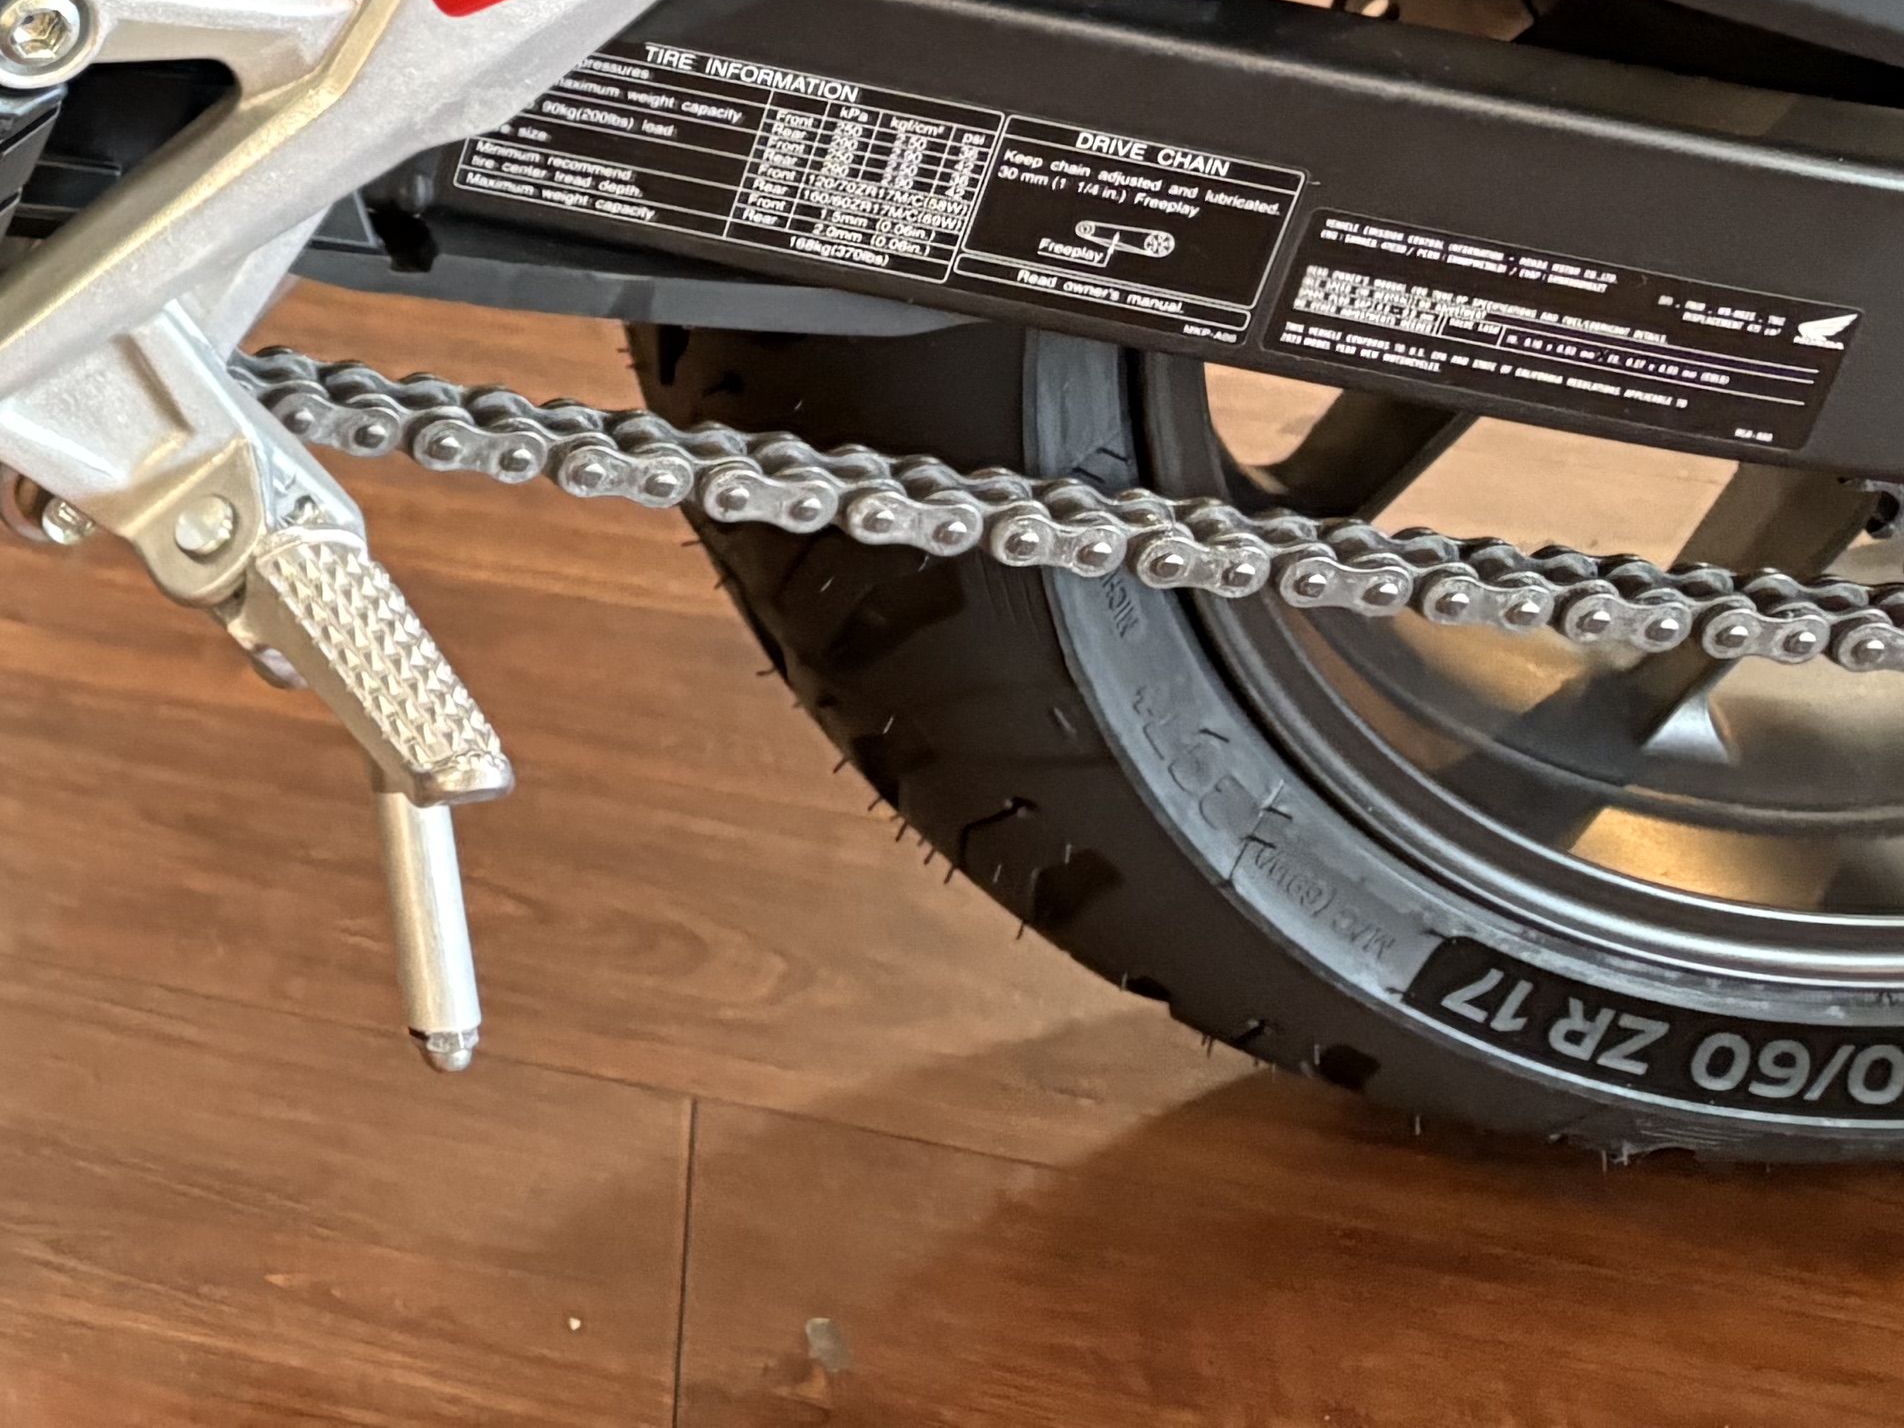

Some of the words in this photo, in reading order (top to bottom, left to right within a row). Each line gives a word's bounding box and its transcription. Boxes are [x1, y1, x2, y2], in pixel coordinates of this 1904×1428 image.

[641, 44, 696, 71] TIRE
[702, 56, 861, 103] INFORMATION
[626, 90, 675, 109] weight
[680, 100, 743, 124] capacity
[774, 108, 816, 129] Front
[517, 126, 548, 142] size
[640, 118, 675, 137] load
[770, 121, 809, 141] Rear
[839, 106, 869, 123] kPa
[960, 132, 986, 146] psi
[475, 140, 541, 163] Minimum
[546, 155, 633, 181] recommend
[761, 147, 799, 168] Rear
[765, 134, 807, 155] Front
[1073, 131, 1149, 161] DRIVE
[1154, 147, 1231, 177] CHAIN
[470, 154, 495, 170] tire
[500, 161, 548, 179] center
[553, 170, 593, 188] tread
[751, 176, 791, 196] Rear
[756, 162, 798, 181] Front
[1002, 148, 1044, 169] Keep
[1049, 159, 1091, 177] chain
[1097, 169, 1163, 192] adjusted
[1167, 183, 1199, 199] and
[1203, 188, 1280, 216] lubricated.
[465, 171, 535, 196] Maximum
[539, 188, 589, 207] weight
[592, 198, 656, 224] capacity
[745, 191, 788, 212] Front
[997, 165, 1018, 180] 30
[1019, 171, 1049, 186] mm
[1133, 191, 1200, 219] Freeplay
[741, 206, 781, 226] Rear
[1037, 237, 1104, 264] Freeplay
[1015, 268, 1059, 289] Read
[1061, 280, 1121, 302] owner's
[1125, 293, 1184, 314] manual.
[1440, 967, 1535, 1033] 17
[1547, 996, 1671, 1076] ZR
